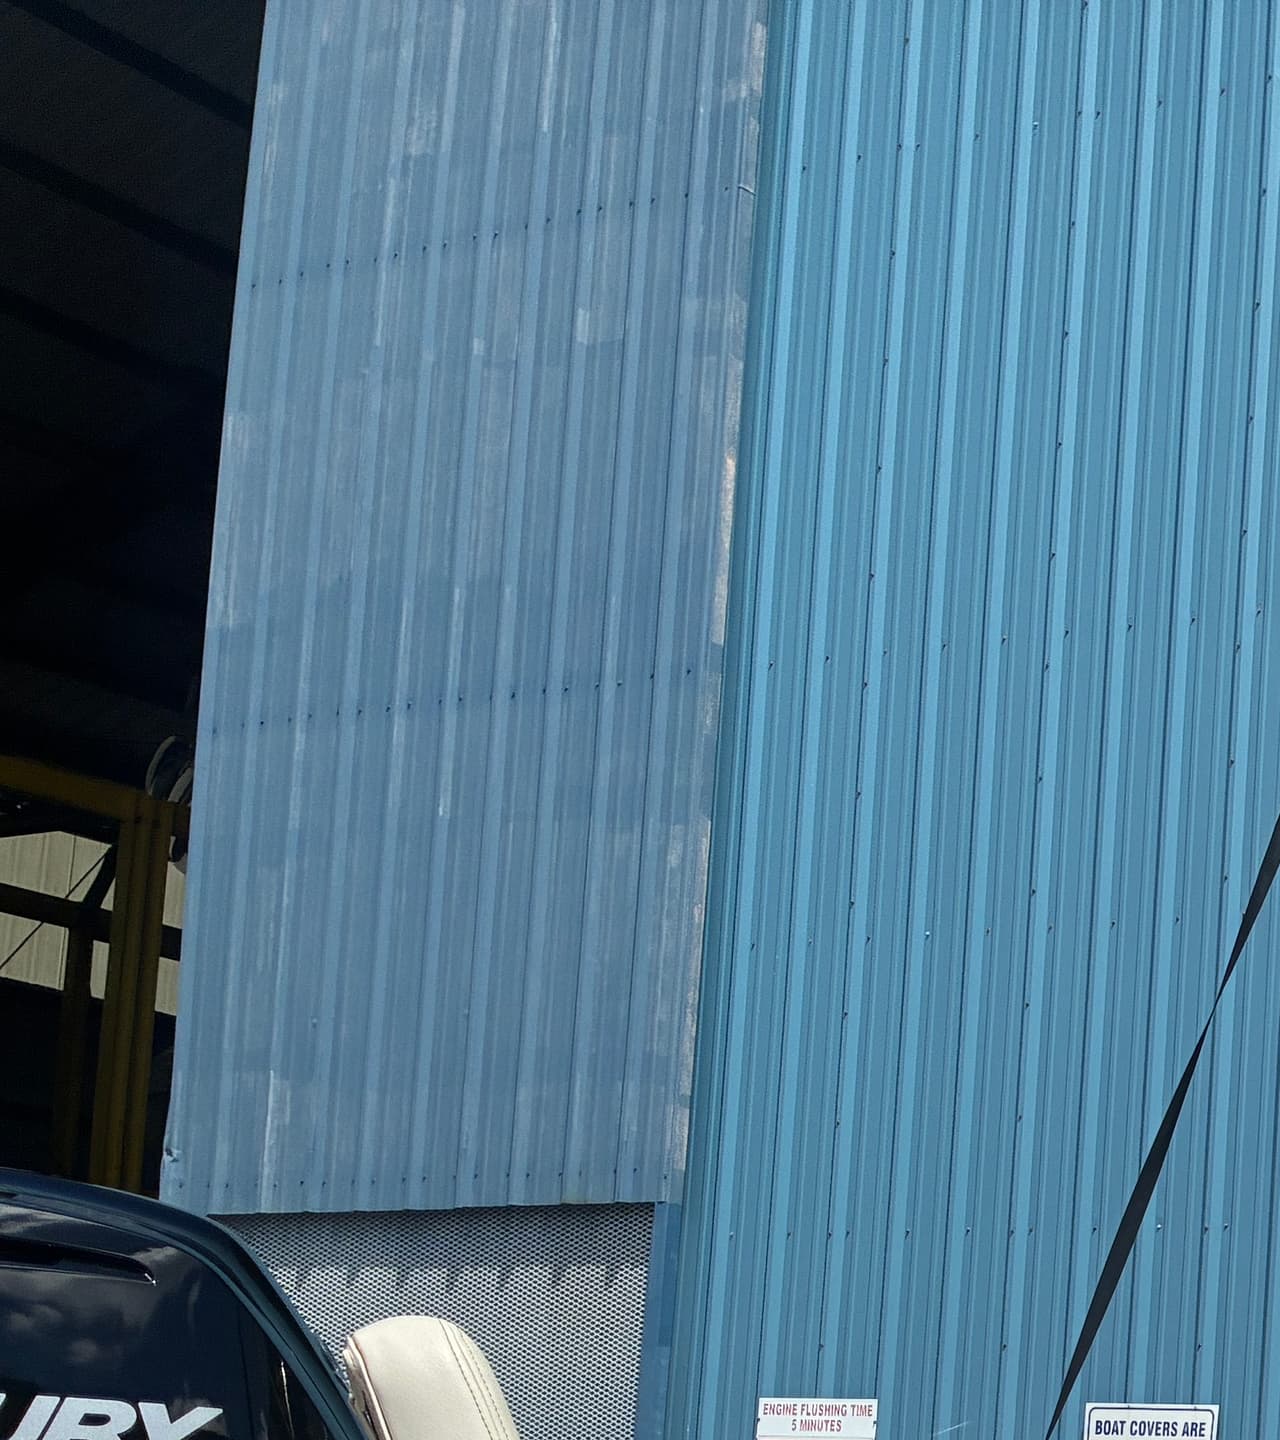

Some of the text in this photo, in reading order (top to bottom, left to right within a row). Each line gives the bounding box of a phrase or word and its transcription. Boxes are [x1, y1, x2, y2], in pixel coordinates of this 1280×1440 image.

[763, 1403, 873, 1417] ENGINE FLUSHING TIME
[791, 1419, 842, 1432] 5 MINUTES
[1095, 1420, 1206, 1437] BOAT COVERS ARE
